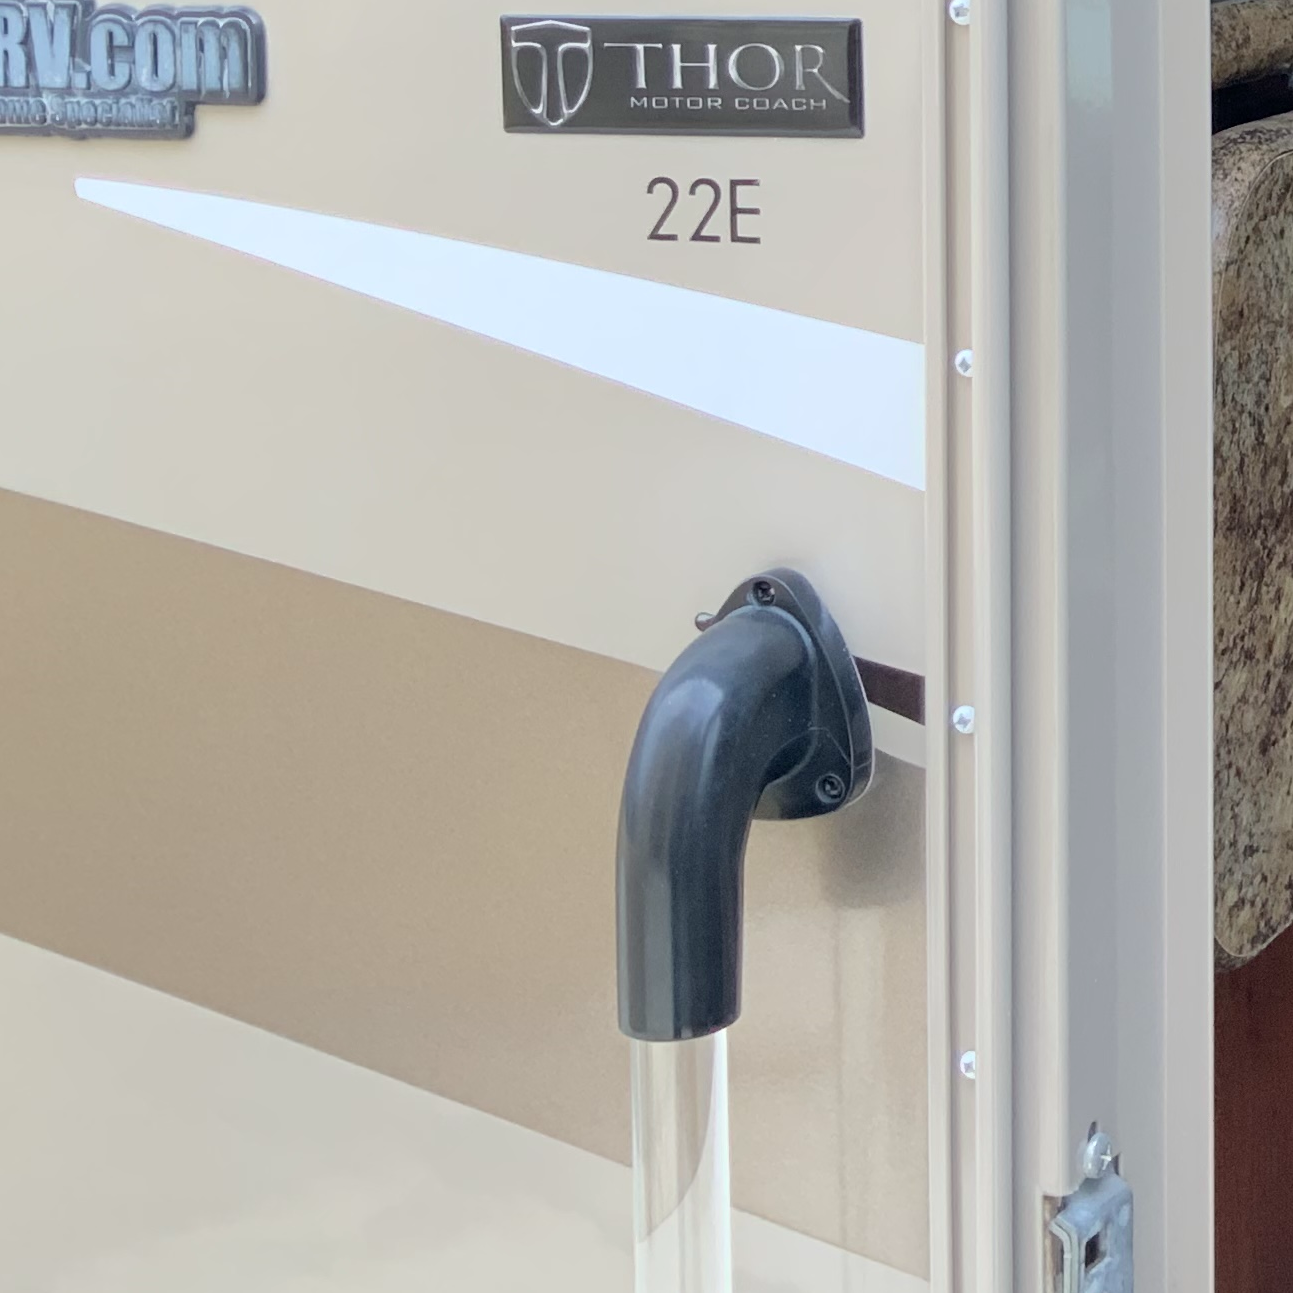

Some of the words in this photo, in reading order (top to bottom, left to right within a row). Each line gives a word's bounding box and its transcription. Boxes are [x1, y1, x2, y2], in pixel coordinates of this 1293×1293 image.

[603, 42, 851, 103] THOR
[630, 96, 722, 110] MOTOR
[734, 97, 827, 111] COACH
[646, 176, 761, 244] 22E
